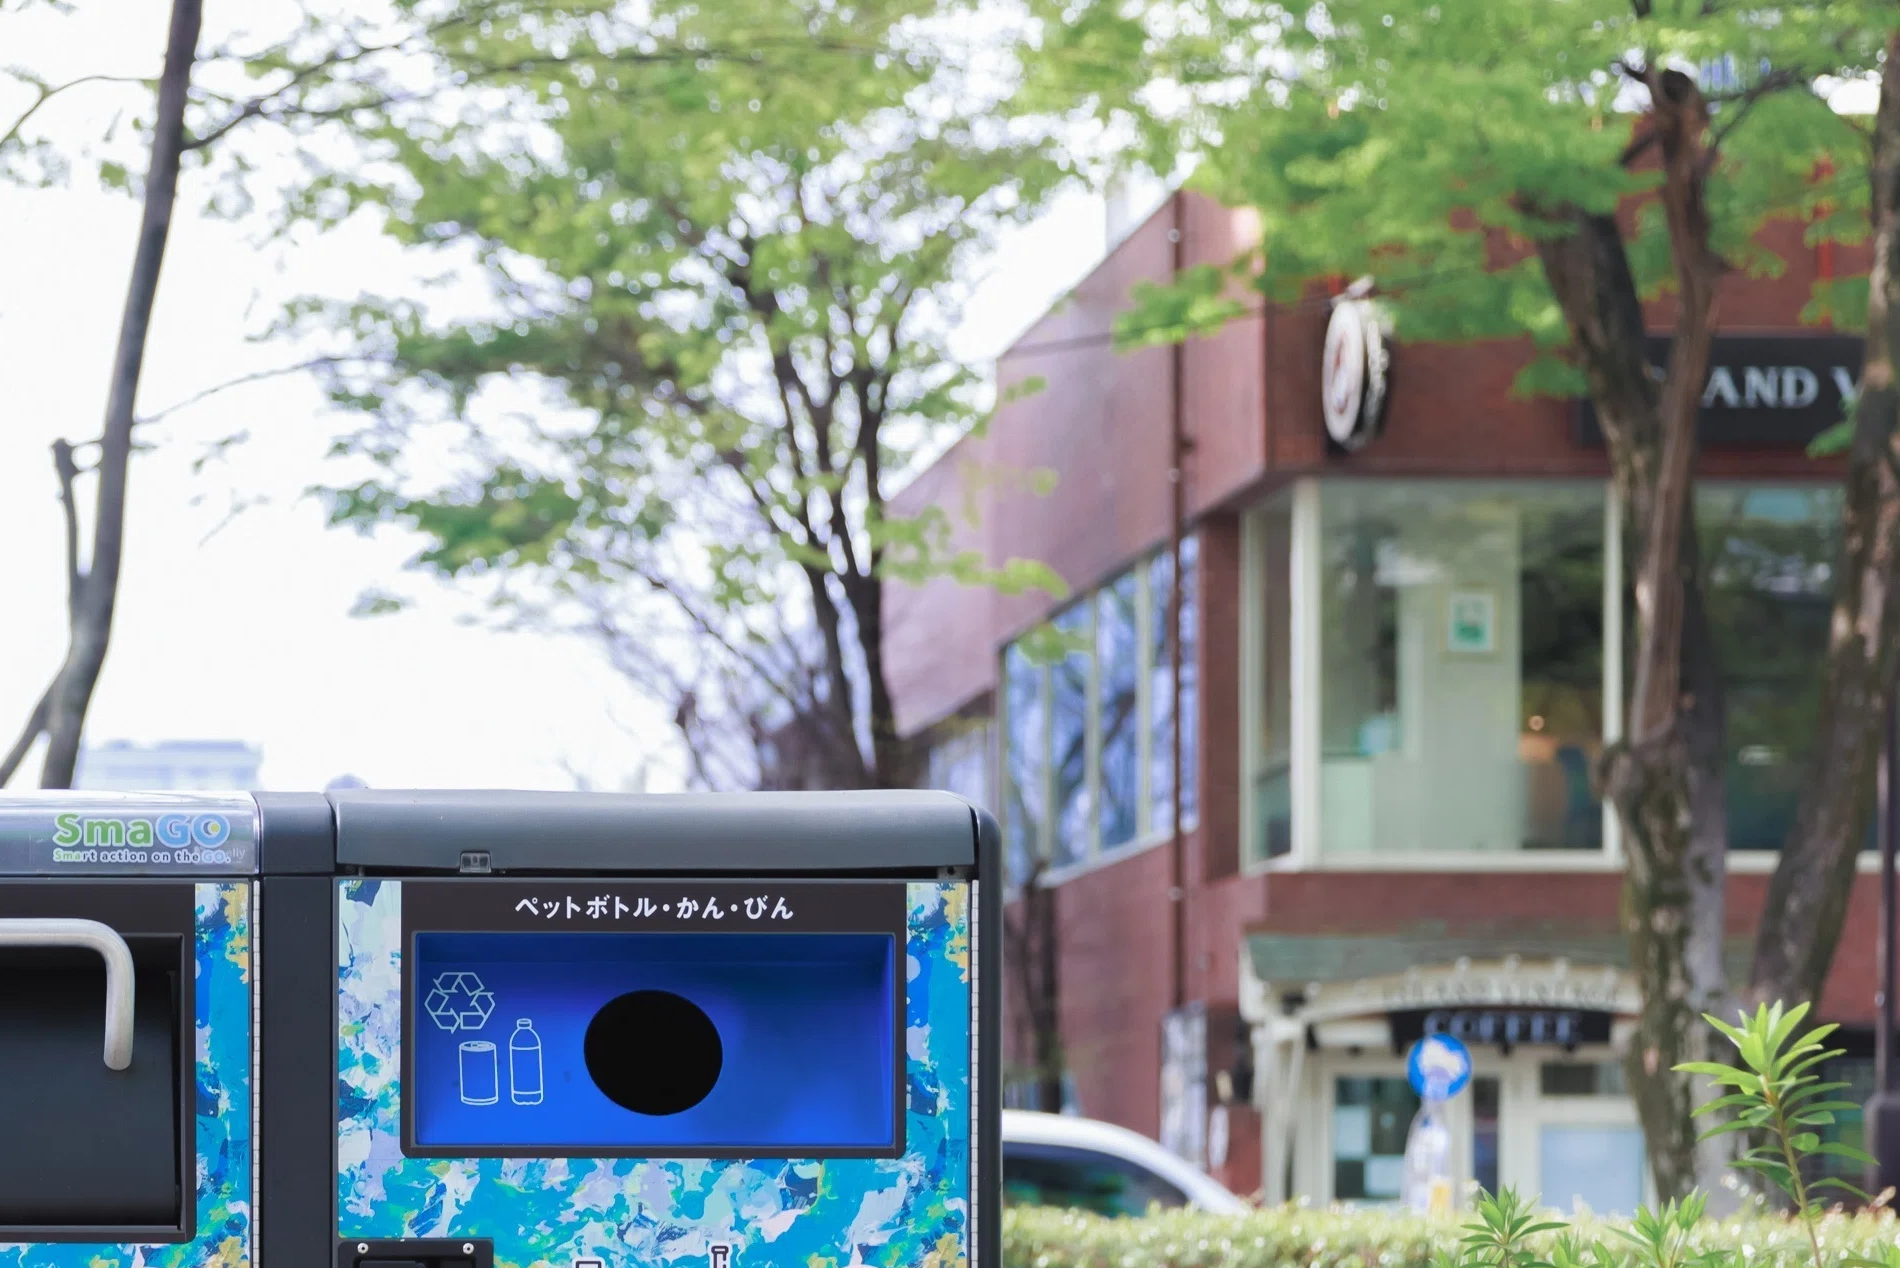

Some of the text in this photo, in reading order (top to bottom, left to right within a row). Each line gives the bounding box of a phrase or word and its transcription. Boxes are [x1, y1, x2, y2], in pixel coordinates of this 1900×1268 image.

[1700, 364, 1820, 409] AND
[53, 813, 231, 848] SmaGO
[53, 848, 97, 862] Smart
[100, 848, 146, 862] action
[151, 849, 170, 862] on
[175, 848, 200, 862] the
[514, 894, 794, 920] ペットボトル・かん・びん
